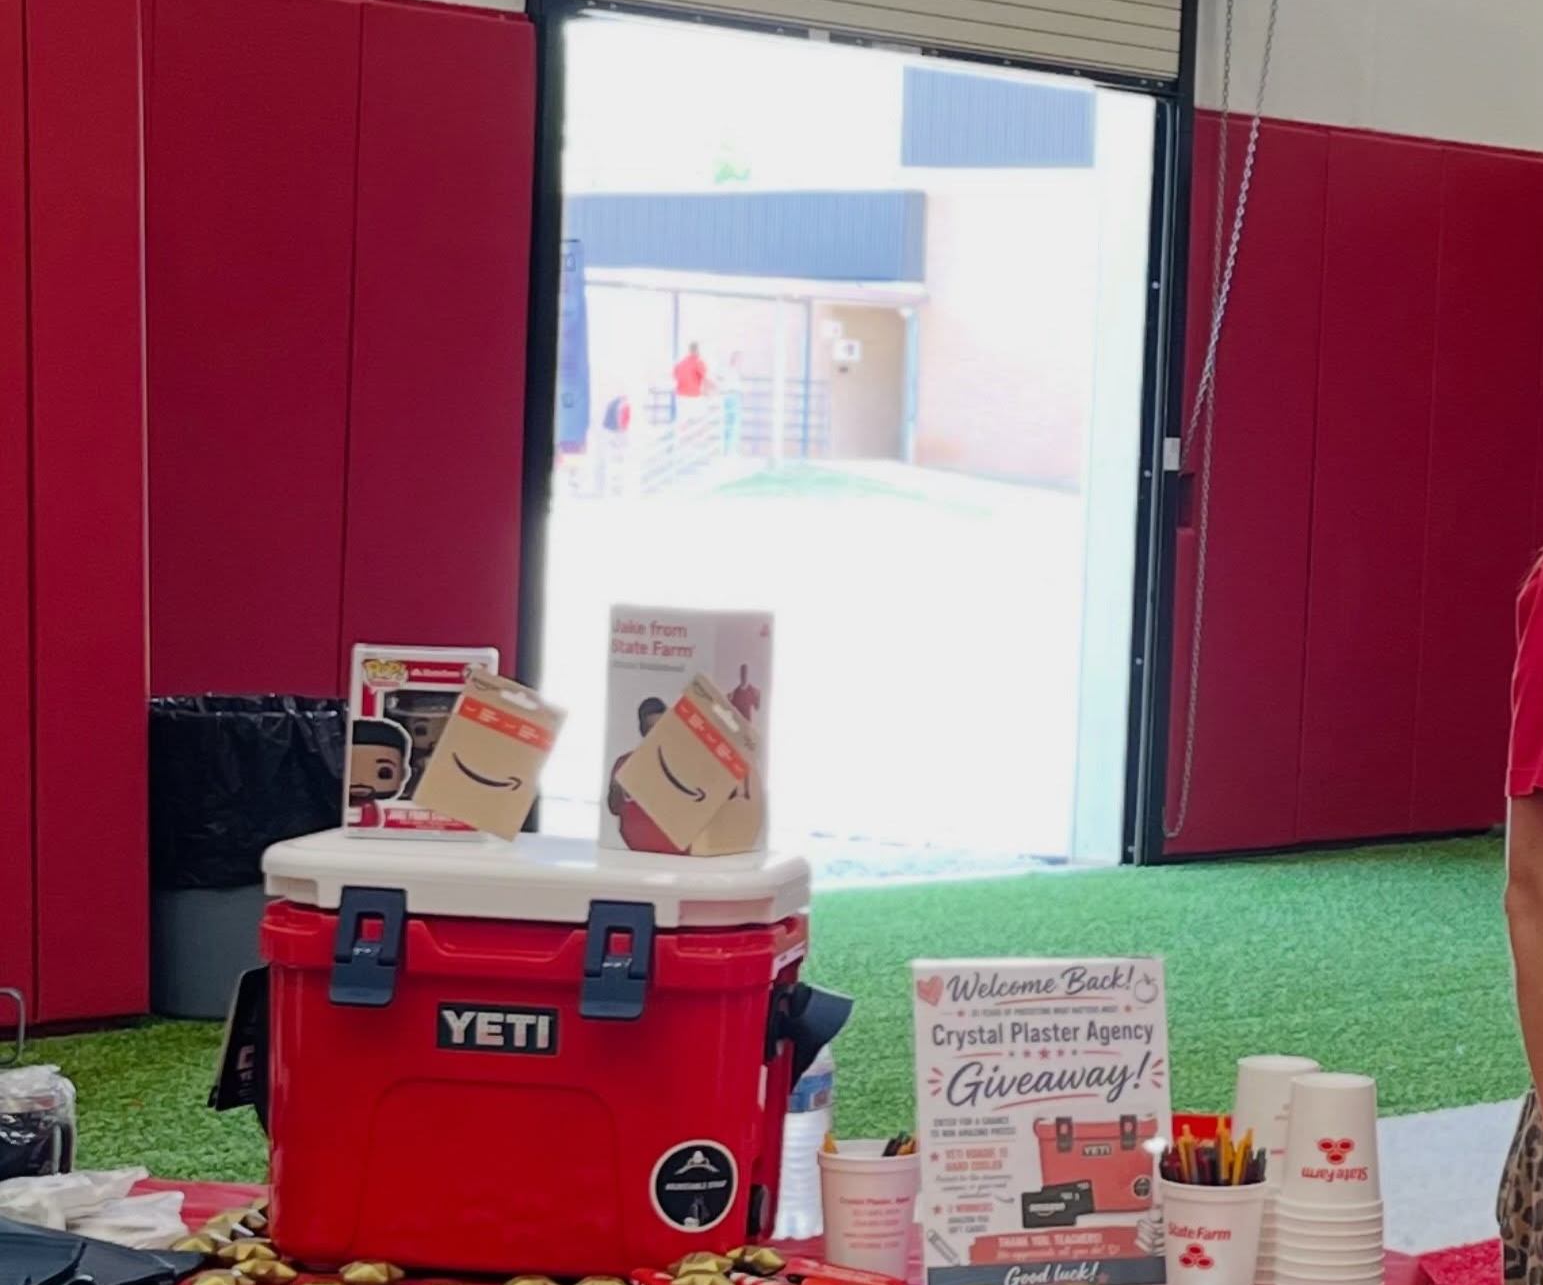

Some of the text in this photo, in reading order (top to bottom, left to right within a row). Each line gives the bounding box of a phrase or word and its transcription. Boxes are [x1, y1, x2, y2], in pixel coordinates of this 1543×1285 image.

[612, 618, 688, 639] Jake from
[946, 966, 1135, 1002] Welcome Back!
[441, 1008, 551, 1049] YETI
[932, 1020, 1154, 1051] Crystal Plaster Agency
[946, 1051, 1153, 1107] Giveaway!
[1196, 1227, 1232, 1241] Farm
[1053, 1261, 1100, 1282] luck!
